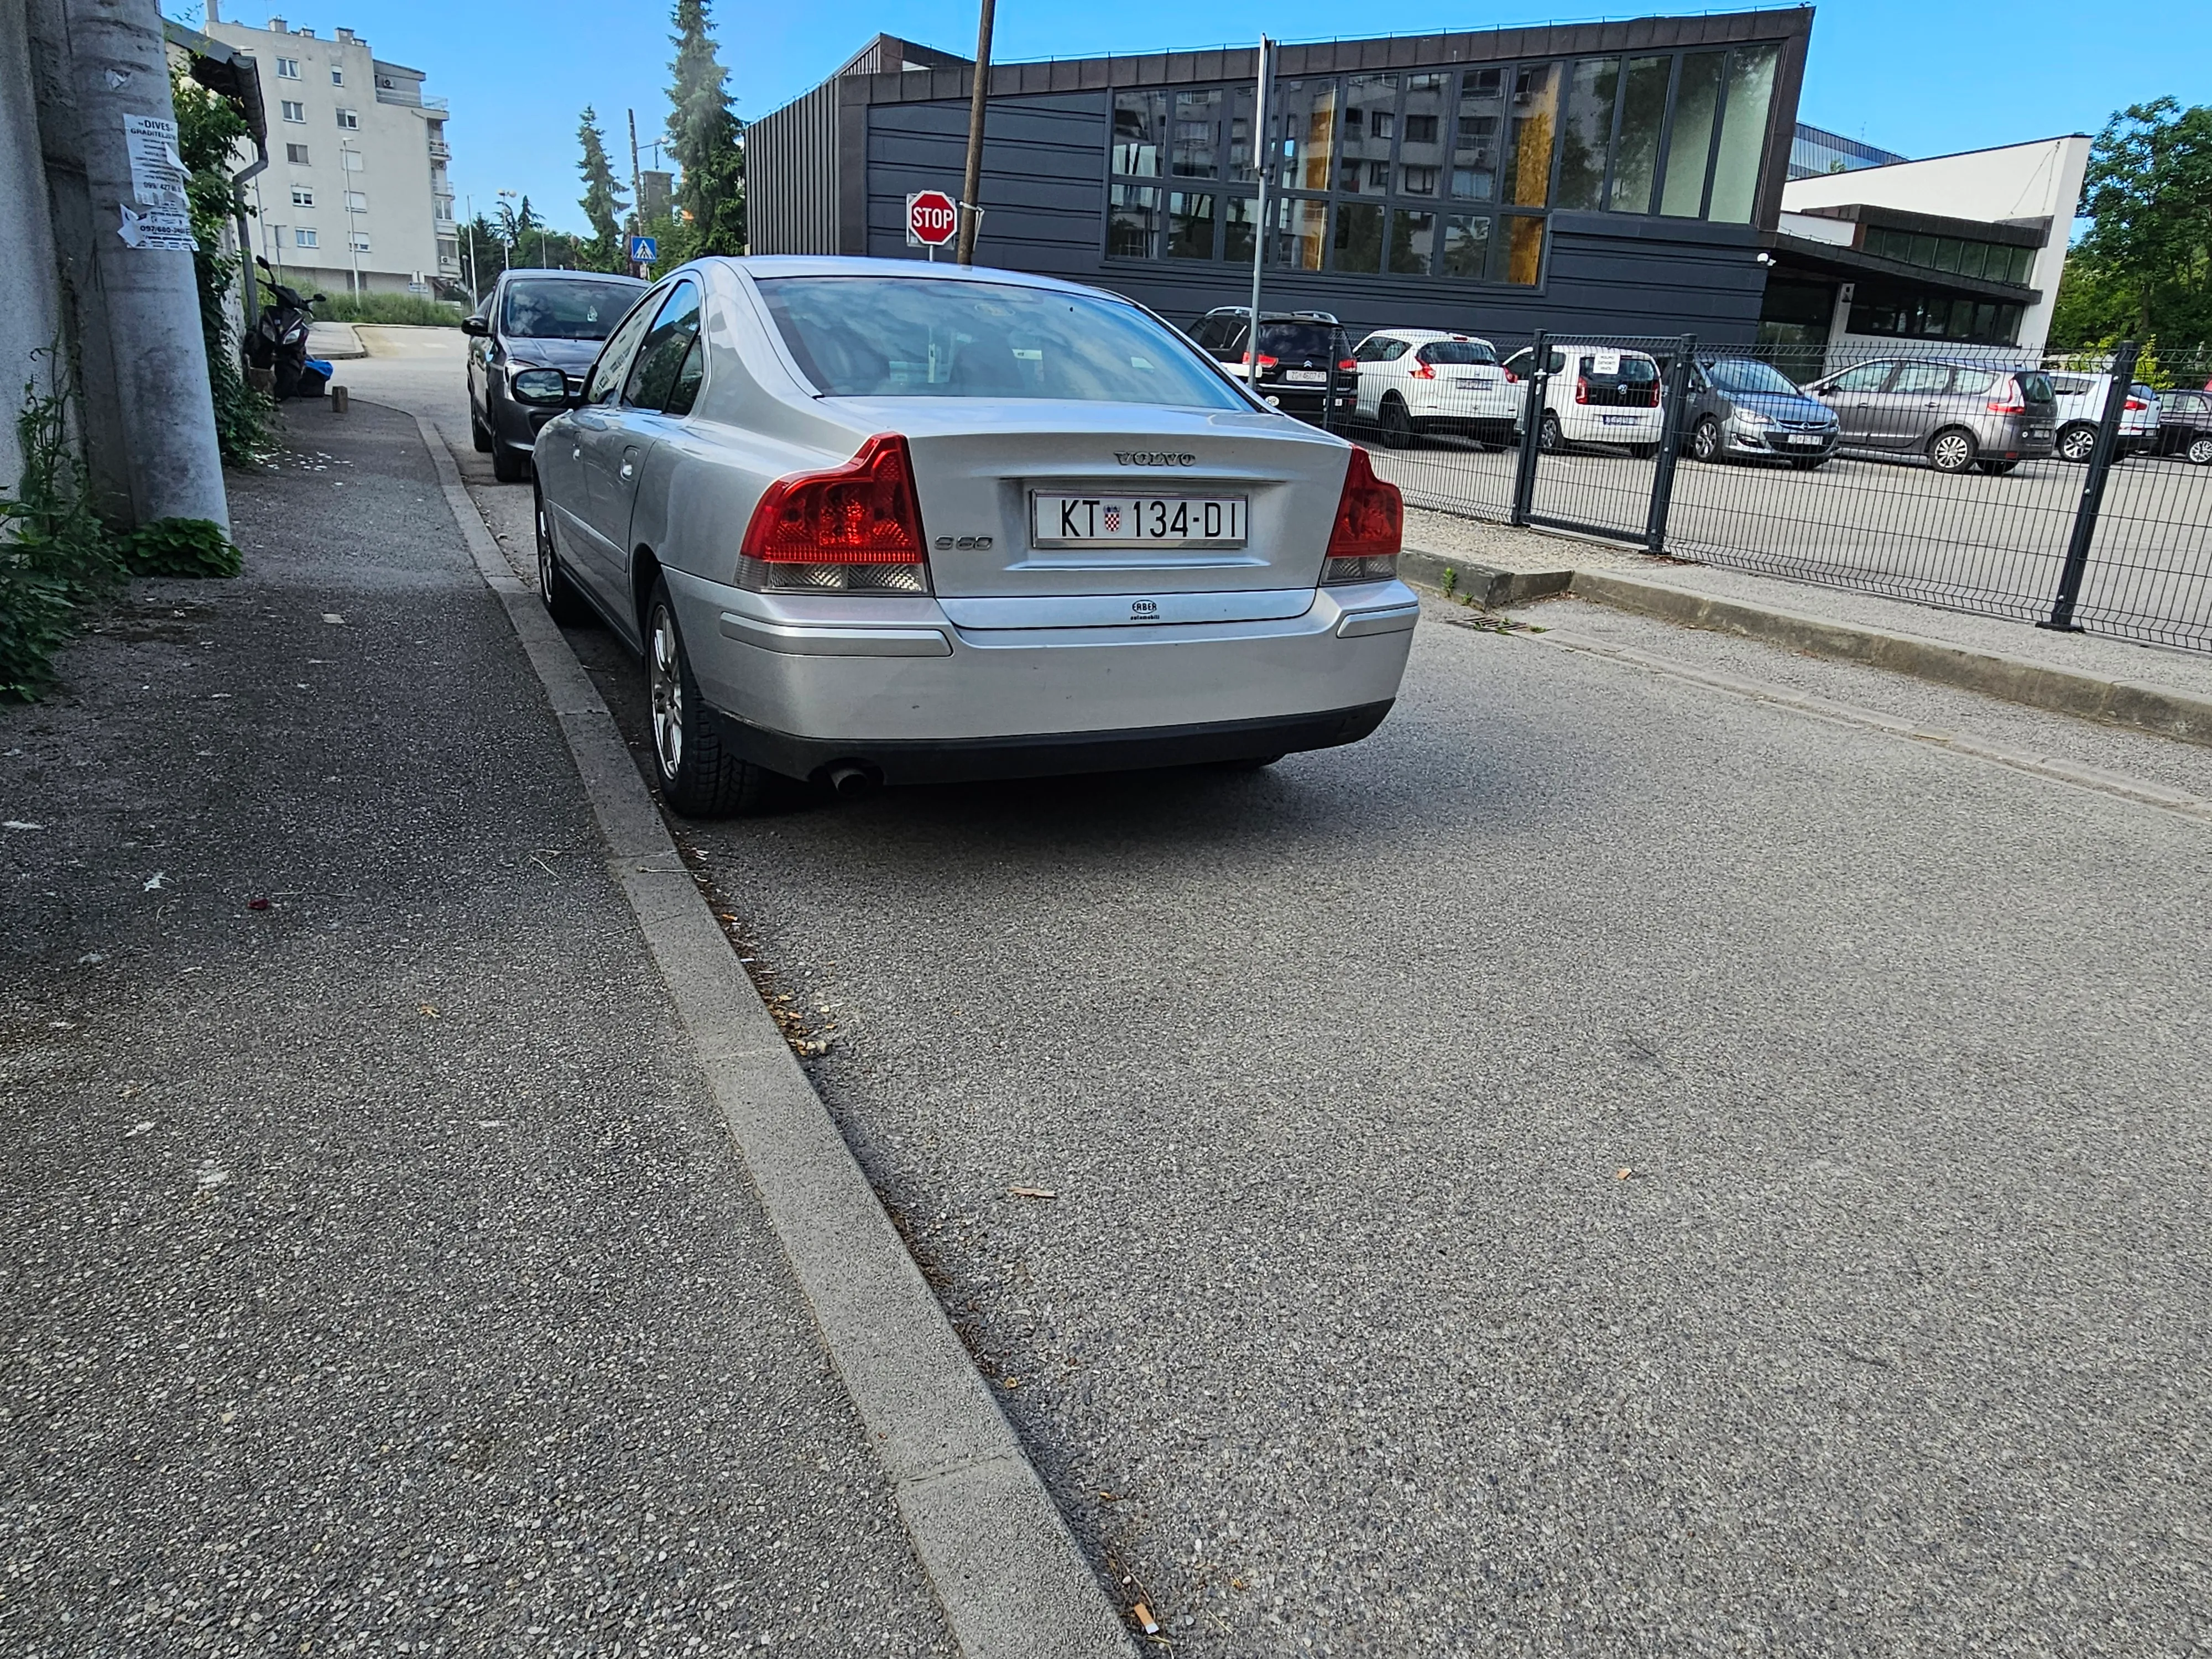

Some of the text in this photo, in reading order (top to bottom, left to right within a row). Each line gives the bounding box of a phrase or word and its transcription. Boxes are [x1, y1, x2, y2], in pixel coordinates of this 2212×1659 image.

[913, 206, 953, 229] STOP
[1113, 451, 1197, 467] VOLVO
[1060, 499, 1100, 537] KT
